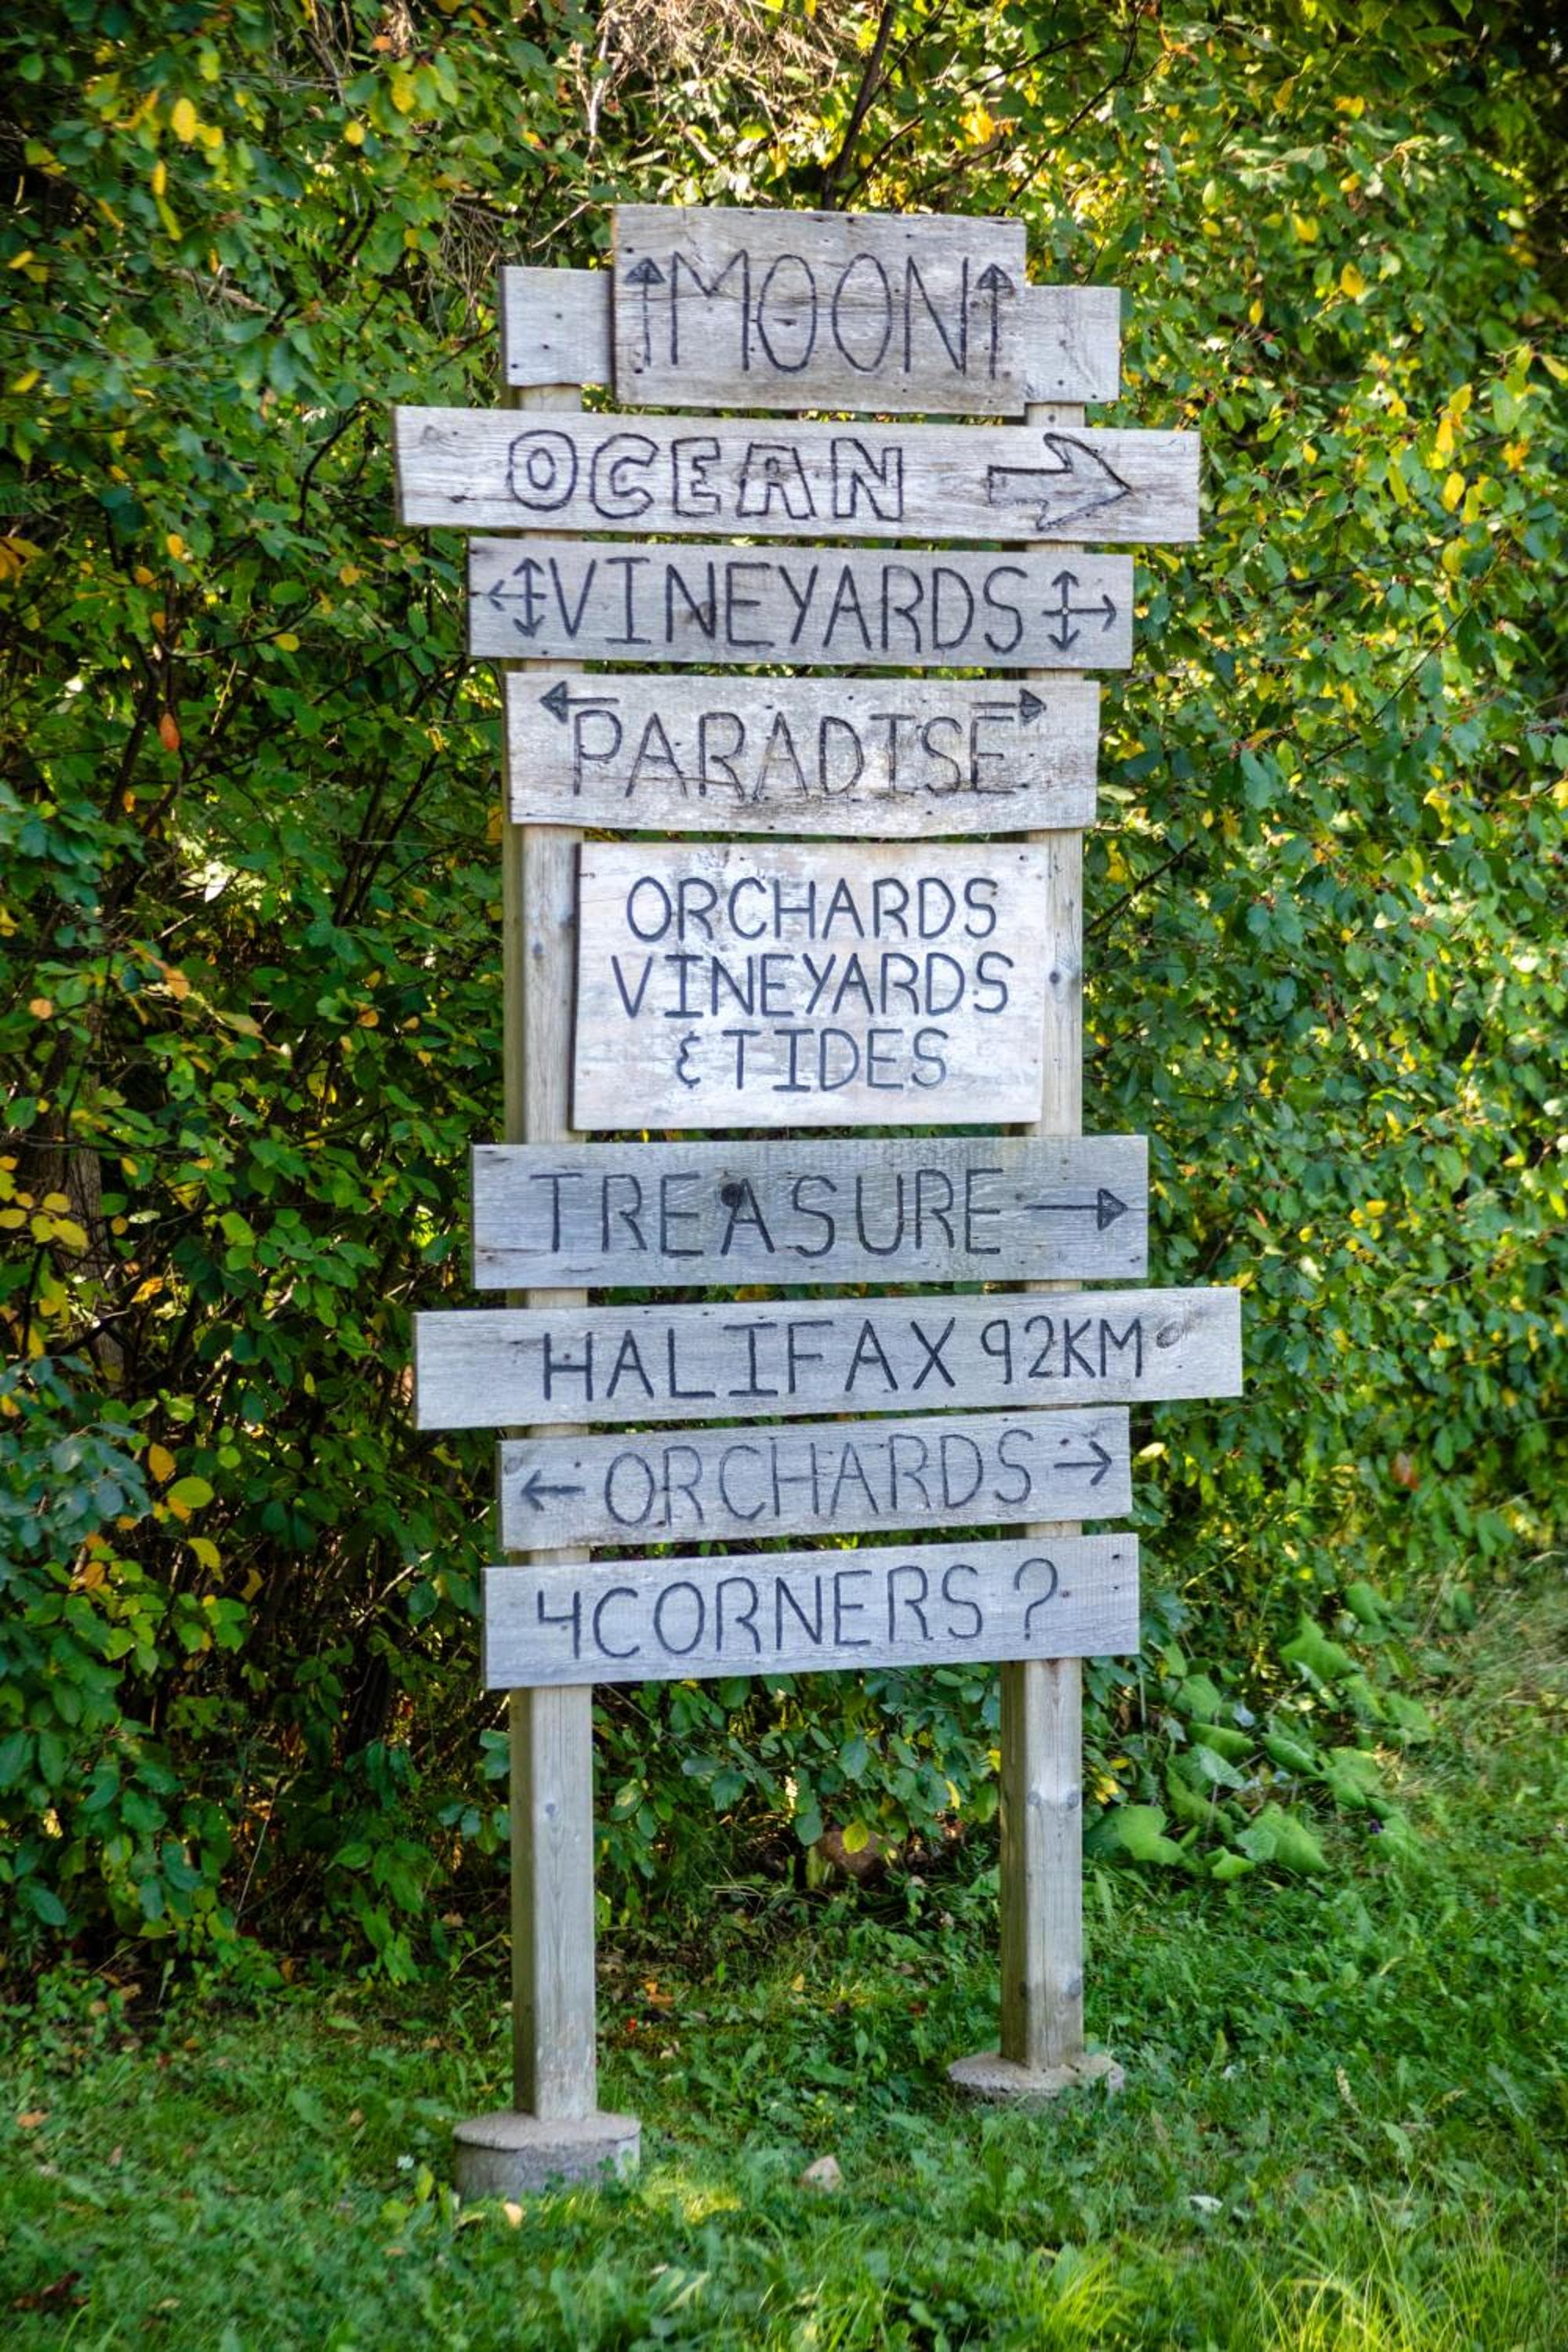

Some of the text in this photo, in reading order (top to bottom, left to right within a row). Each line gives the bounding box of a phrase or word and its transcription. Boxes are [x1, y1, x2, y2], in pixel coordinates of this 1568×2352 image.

[670, 249, 969, 375] MOON
[506, 428, 906, 522] OCEAN
[549, 557, 1029, 655] VINEYARDS
[572, 709, 1017, 800] PARADISE
[626, 876, 999, 942] ORCHARDS
[611, 951, 1014, 1019] VINEYARDS
[675, 1028, 950, 1092] & TIDES
[529, 1167, 1004, 1256] TREASURE
[542, 1316, 957, 1402] HALIFAX
[604, 1428, 1036, 1526] ORCHARDS
